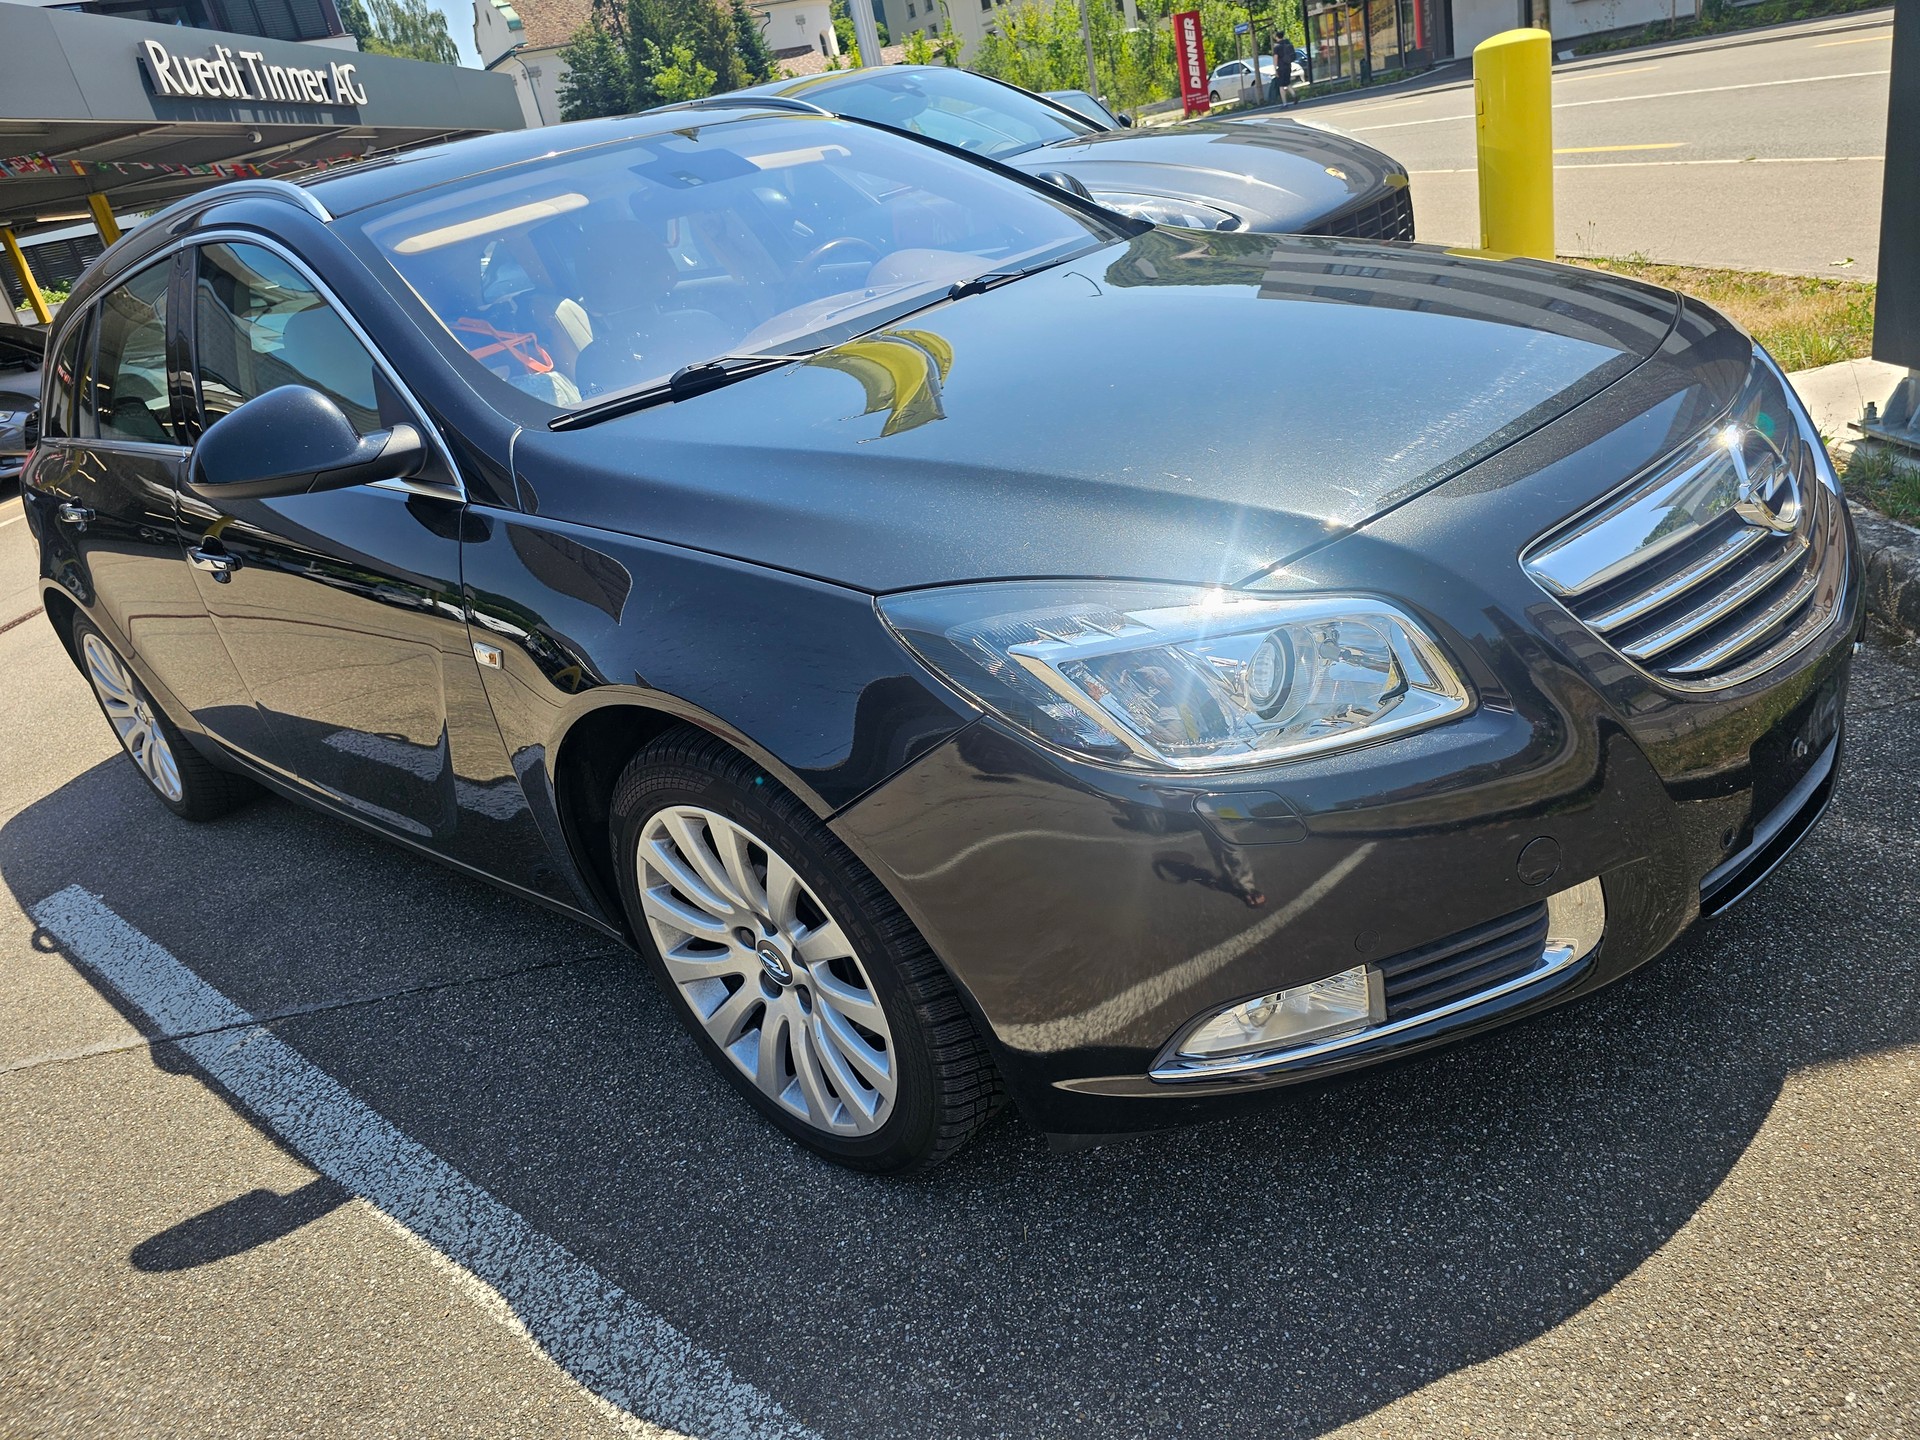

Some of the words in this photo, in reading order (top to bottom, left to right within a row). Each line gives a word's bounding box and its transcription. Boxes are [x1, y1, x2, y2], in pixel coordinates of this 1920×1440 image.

[143, 40, 242, 98] Ruedi
[239, 51, 329, 103] Tinner
[329, 61, 369, 106] AG
[1183, 17, 1202, 89] DENNER
